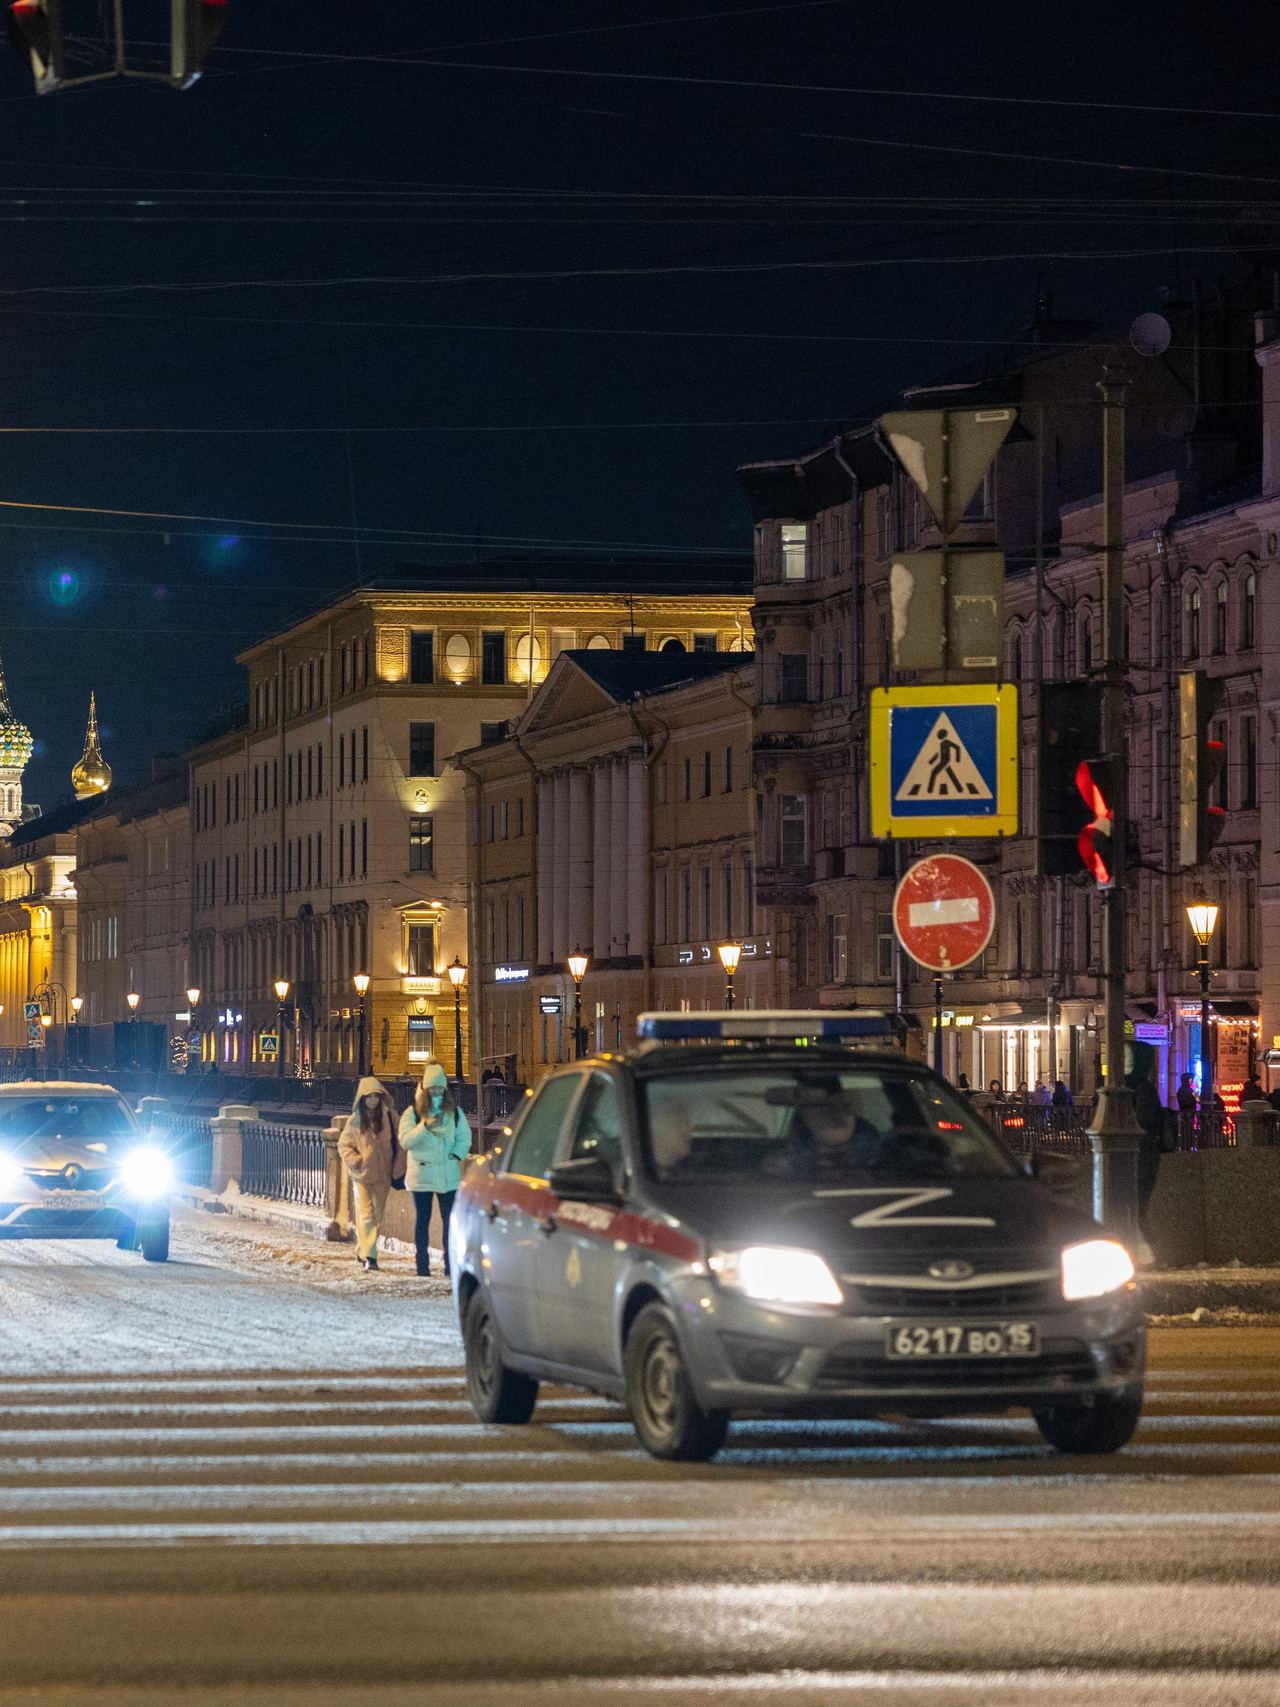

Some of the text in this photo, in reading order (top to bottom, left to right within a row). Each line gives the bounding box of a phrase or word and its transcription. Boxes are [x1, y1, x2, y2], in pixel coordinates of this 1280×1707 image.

[813, 1188, 996, 1227] Z
[895, 1326, 963, 1355] 6217
[1008, 1323, 1032, 1346] 15
